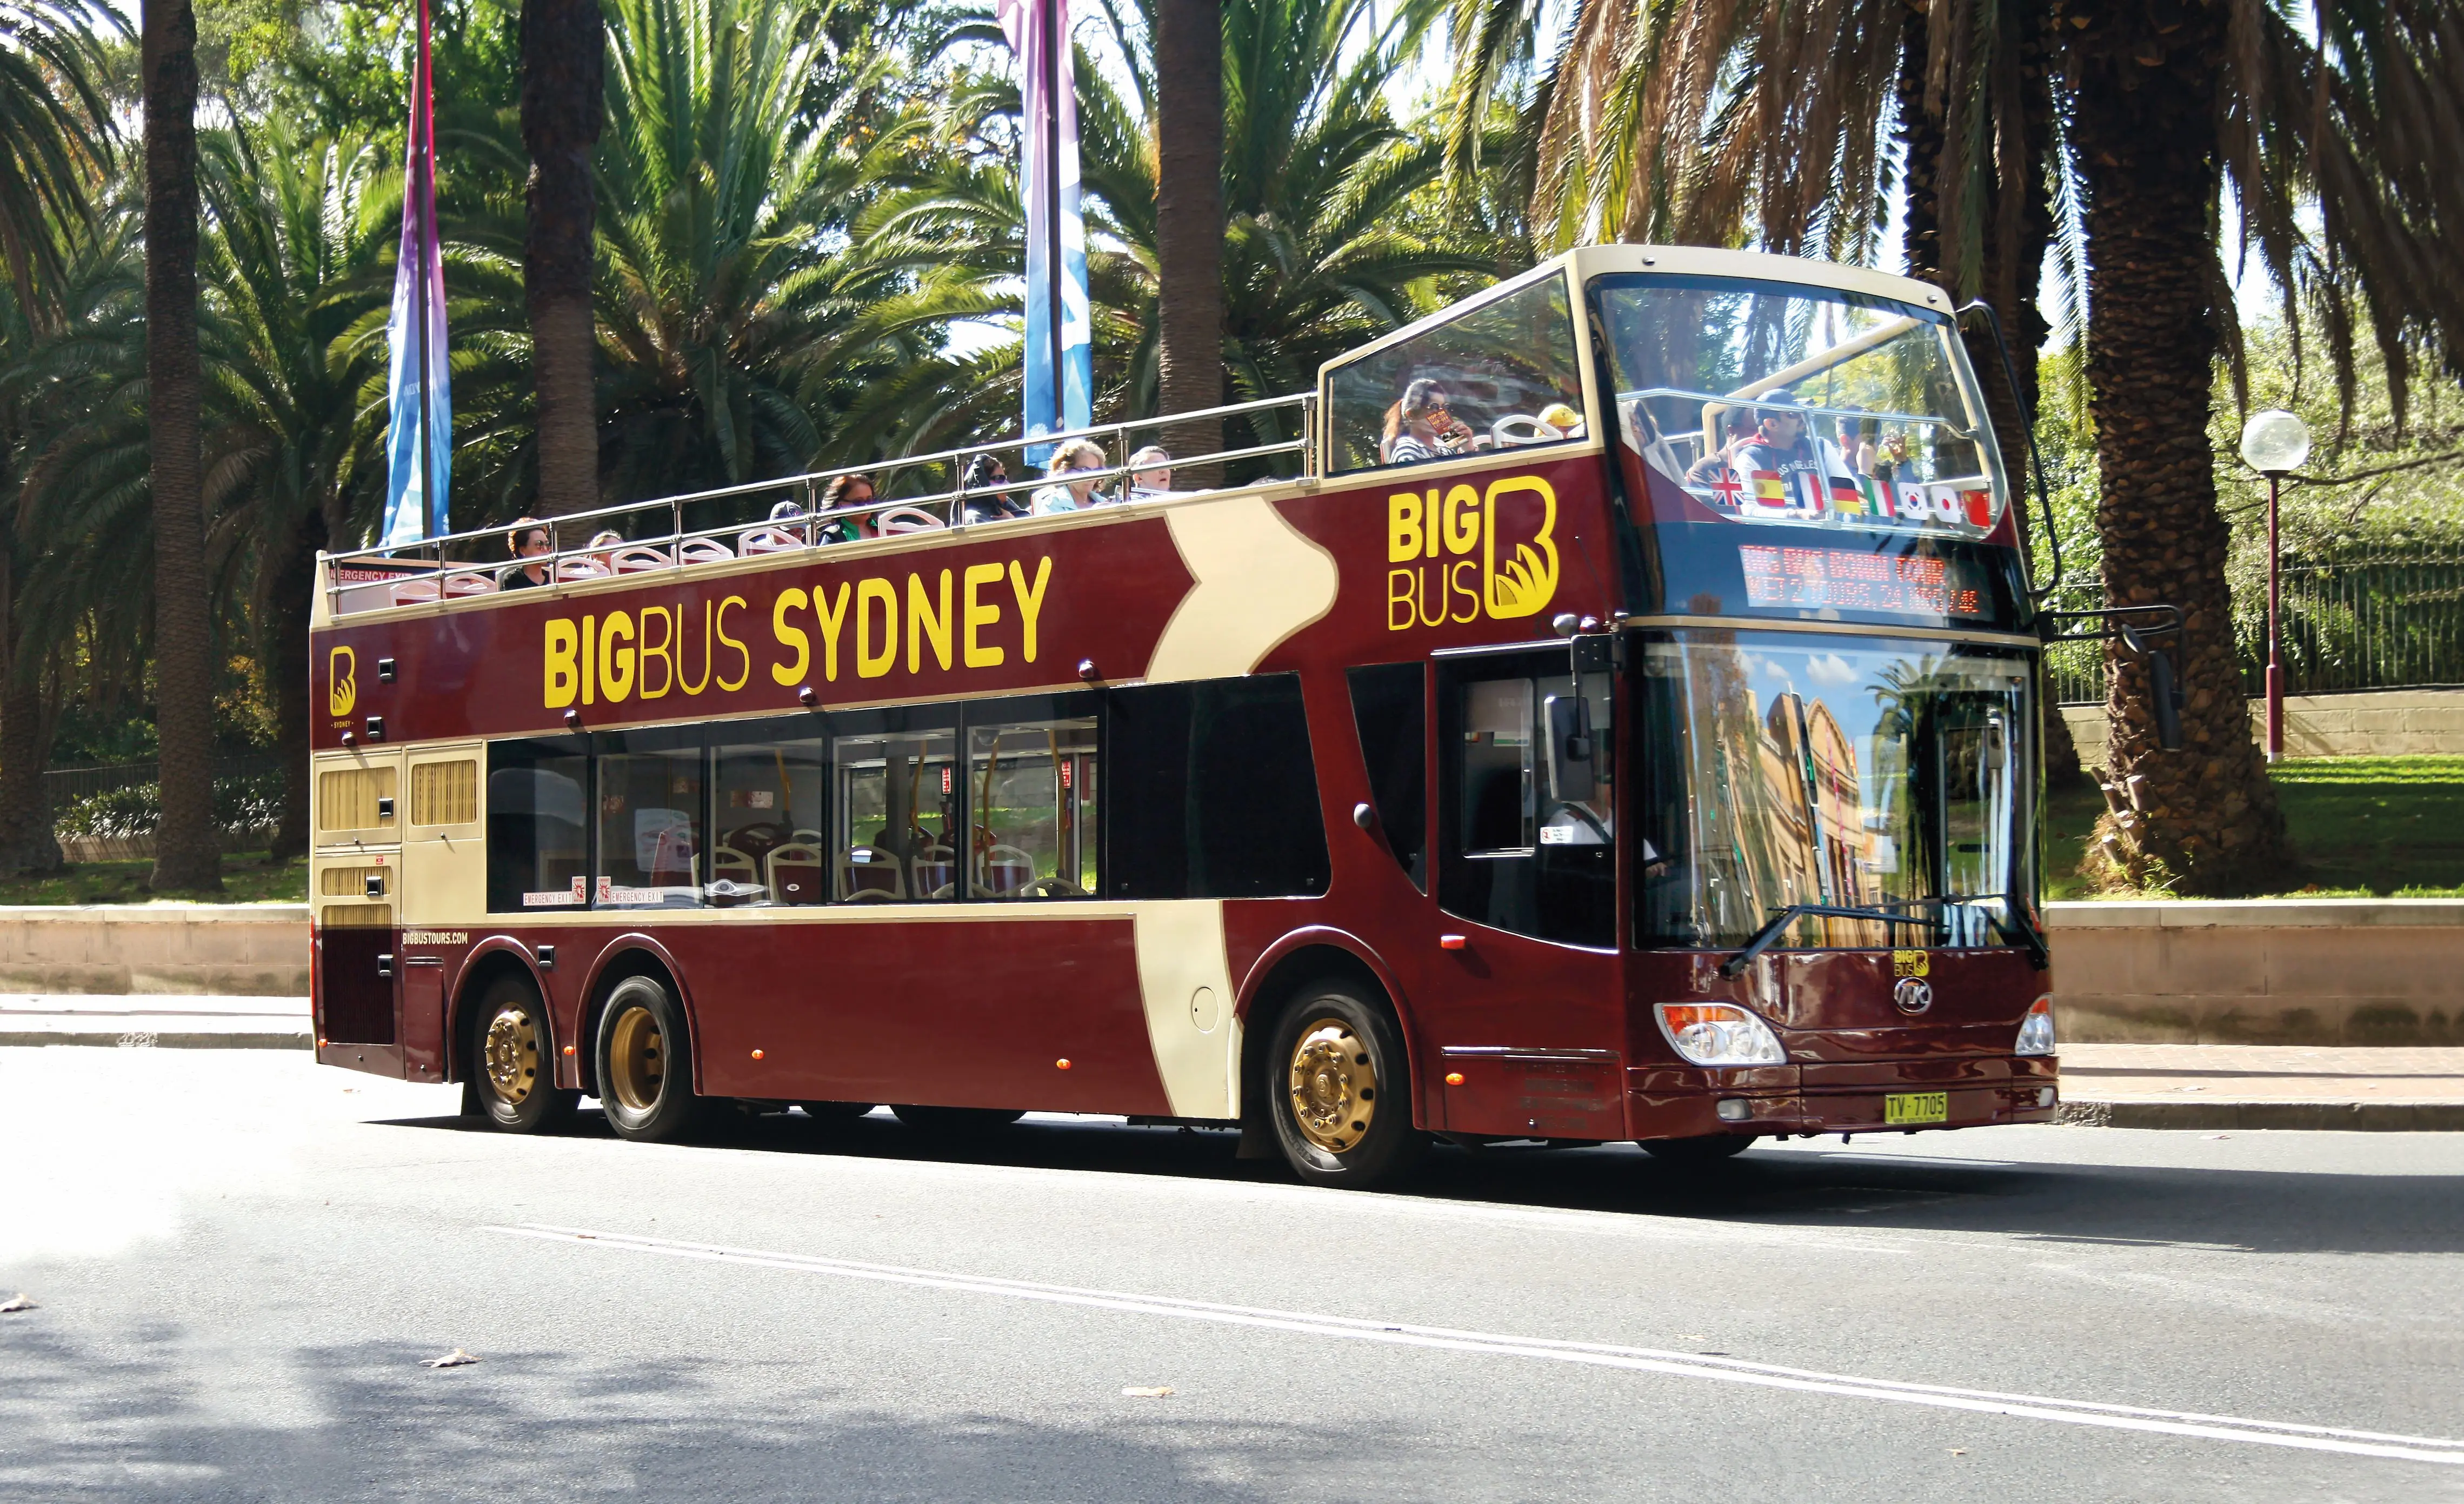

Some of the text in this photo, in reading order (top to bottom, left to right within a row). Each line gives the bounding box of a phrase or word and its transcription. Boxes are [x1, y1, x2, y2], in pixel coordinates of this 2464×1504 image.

[1388, 484, 1480, 563] BIG
[1388, 560, 1480, 631] BUS
[772, 556, 1053, 687] SYDNEY
[334, 720, 351, 729] SYDNEY
[524, 893, 572, 904] EMERGENCY EXIT
[612, 890, 663, 902] EMERGENCY EXIT
[402, 932, 468, 944] BIGBUSTOURS.COM
[1894, 949, 1913, 963] BIG
